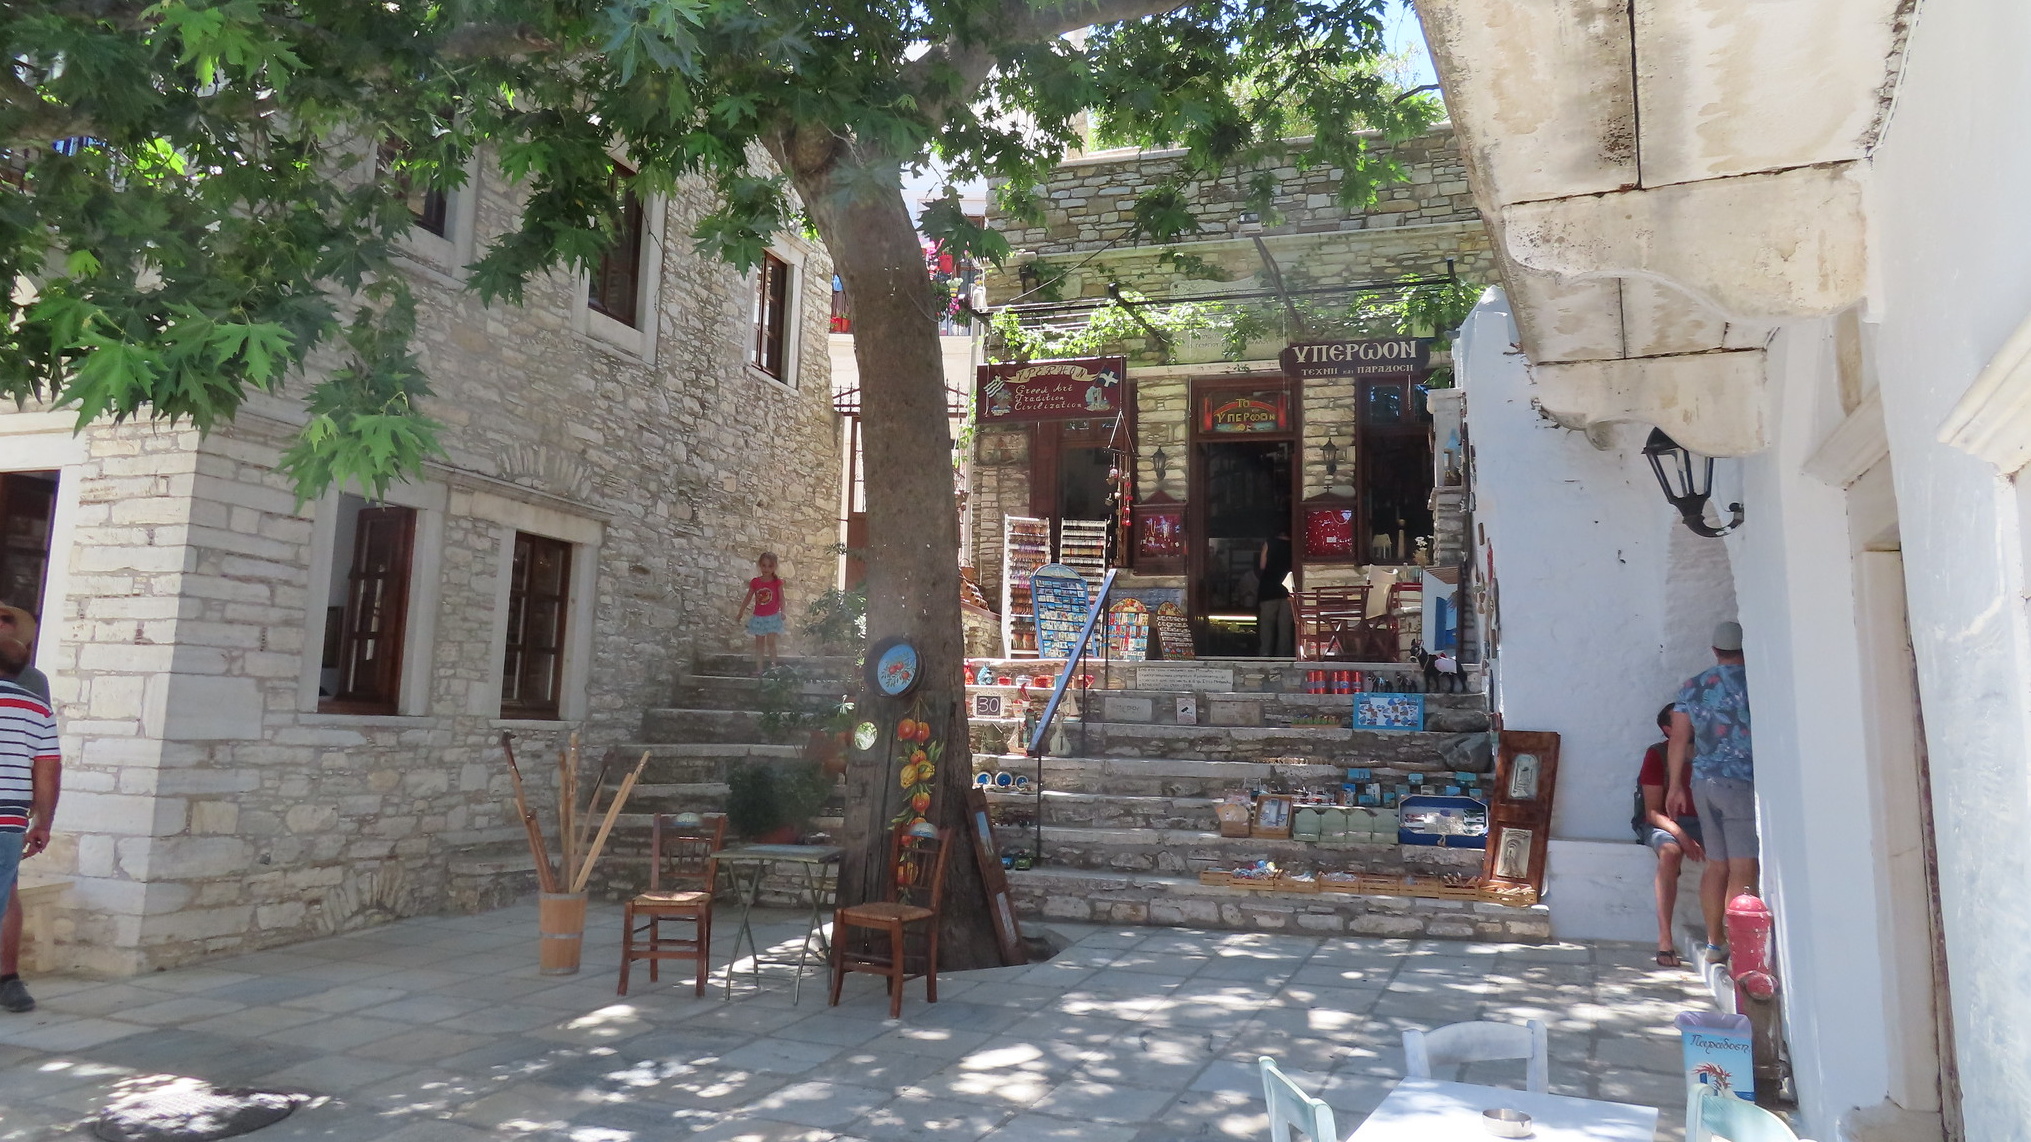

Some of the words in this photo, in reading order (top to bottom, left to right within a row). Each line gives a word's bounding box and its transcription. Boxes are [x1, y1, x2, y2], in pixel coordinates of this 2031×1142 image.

[1292, 340, 1417, 363] ΥΠΕΡΩΟΝ
[1015, 384, 1049, 395] Greek
[1053, 382, 1073, 392] Art
[1014, 394, 1064, 402] Tradition
[1014, 401, 1082, 411] Civilization
[978, 697, 999, 713] 30
